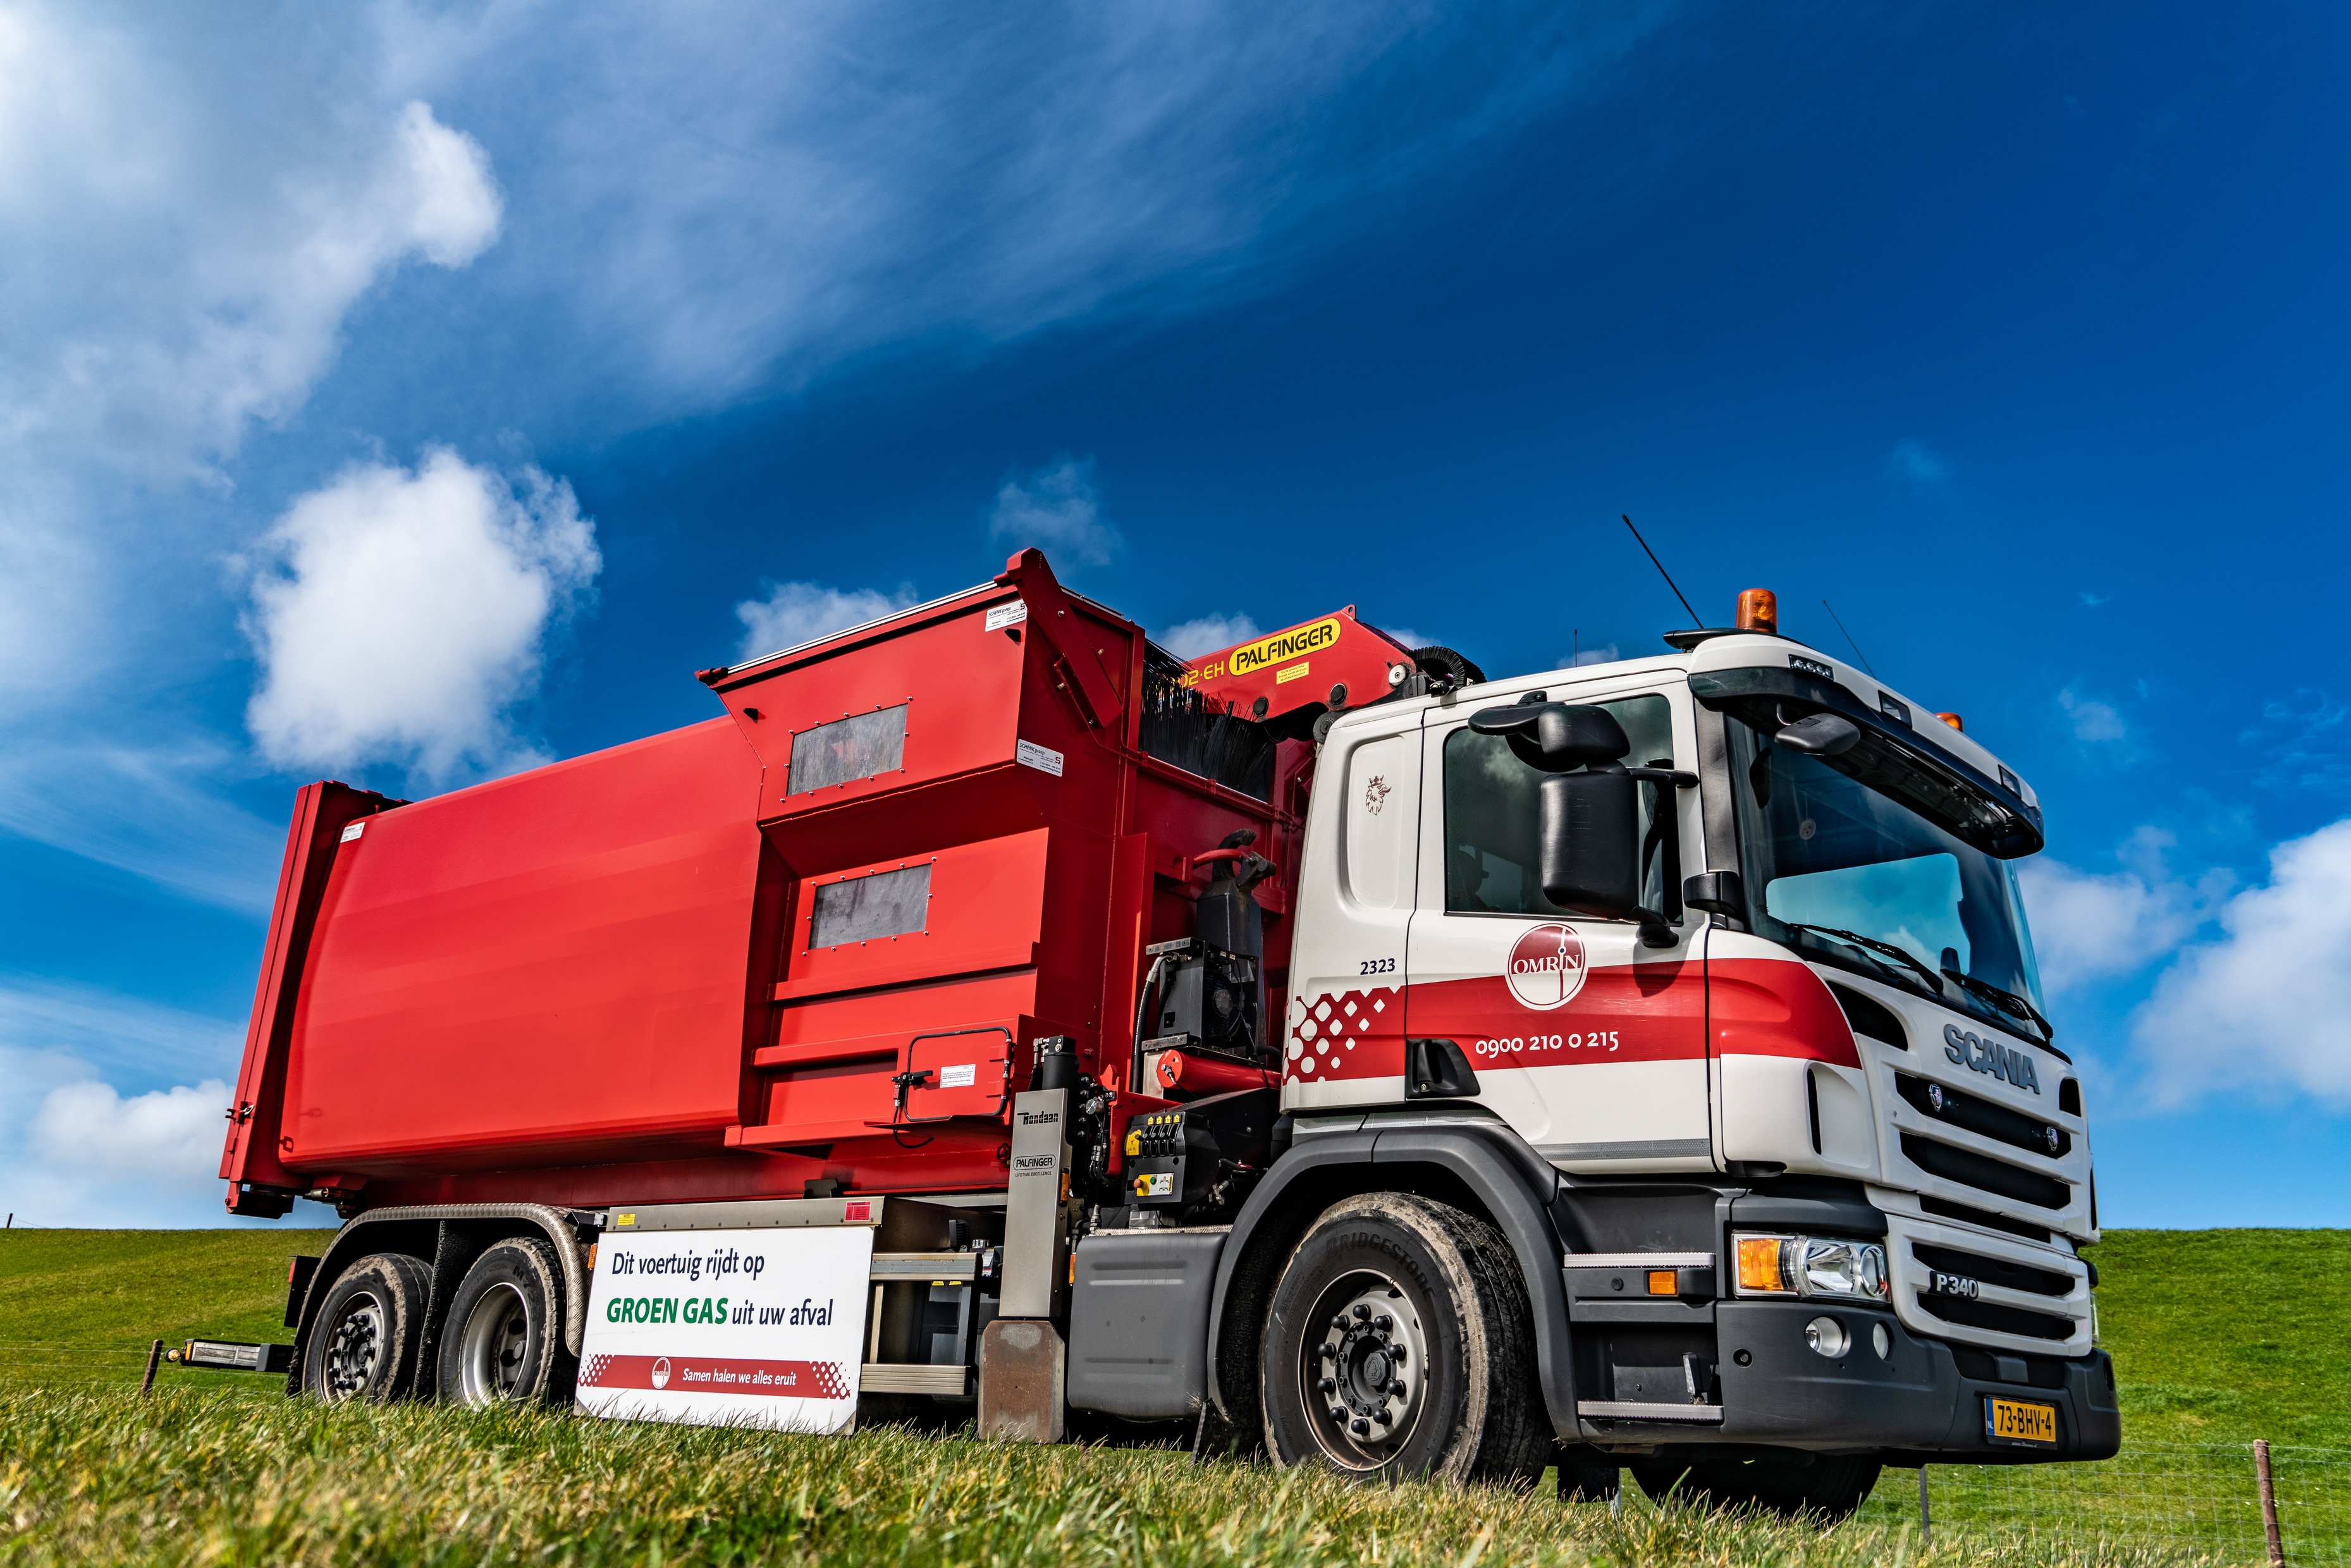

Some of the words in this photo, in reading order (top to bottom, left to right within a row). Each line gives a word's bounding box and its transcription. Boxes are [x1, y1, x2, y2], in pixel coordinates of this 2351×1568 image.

[988, 609, 1002, 617] SCHENK
[1236, 624, 1333, 671] PALFINGER
[1019, 743, 1034, 751] SCHENK
[1360, 957, 1396, 975] 2323
[1513, 953, 1580, 974] OMRIN
[1475, 1037, 1523, 1058] 0900
[1529, 1034, 1562, 1051] 210
[1587, 1031, 1619, 1051] 215
[1944, 1024, 2041, 1095] SCANIA
[1016, 1157, 1053, 1168] PALFINGER
[612, 1251, 635, 1275] Dit
[639, 1249, 702, 1281] voertuig
[706, 1247, 739, 1281] rijdt
[744, 1255, 764, 1280] op
[1326, 1232, 1435, 1302] BRIDGESTONE
[606, 1297, 678, 1323] GROEN
[683, 1297, 728, 1324] GAS
[732, 1299, 754, 1325] uit
[759, 1307, 785, 1325] uw
[790, 1298, 833, 1326] afval
[682, 1368, 711, 1382] Samen
[713, 1368, 736, 1383] halen
[738, 1375, 751, 1383] we
[752, 1369, 773, 1385] alles
[774, 1371, 797, 1386] eruit
[1987, 1421, 1994, 1429] NL
[1998, 1404, 2051, 1436] 73-BHV-4
